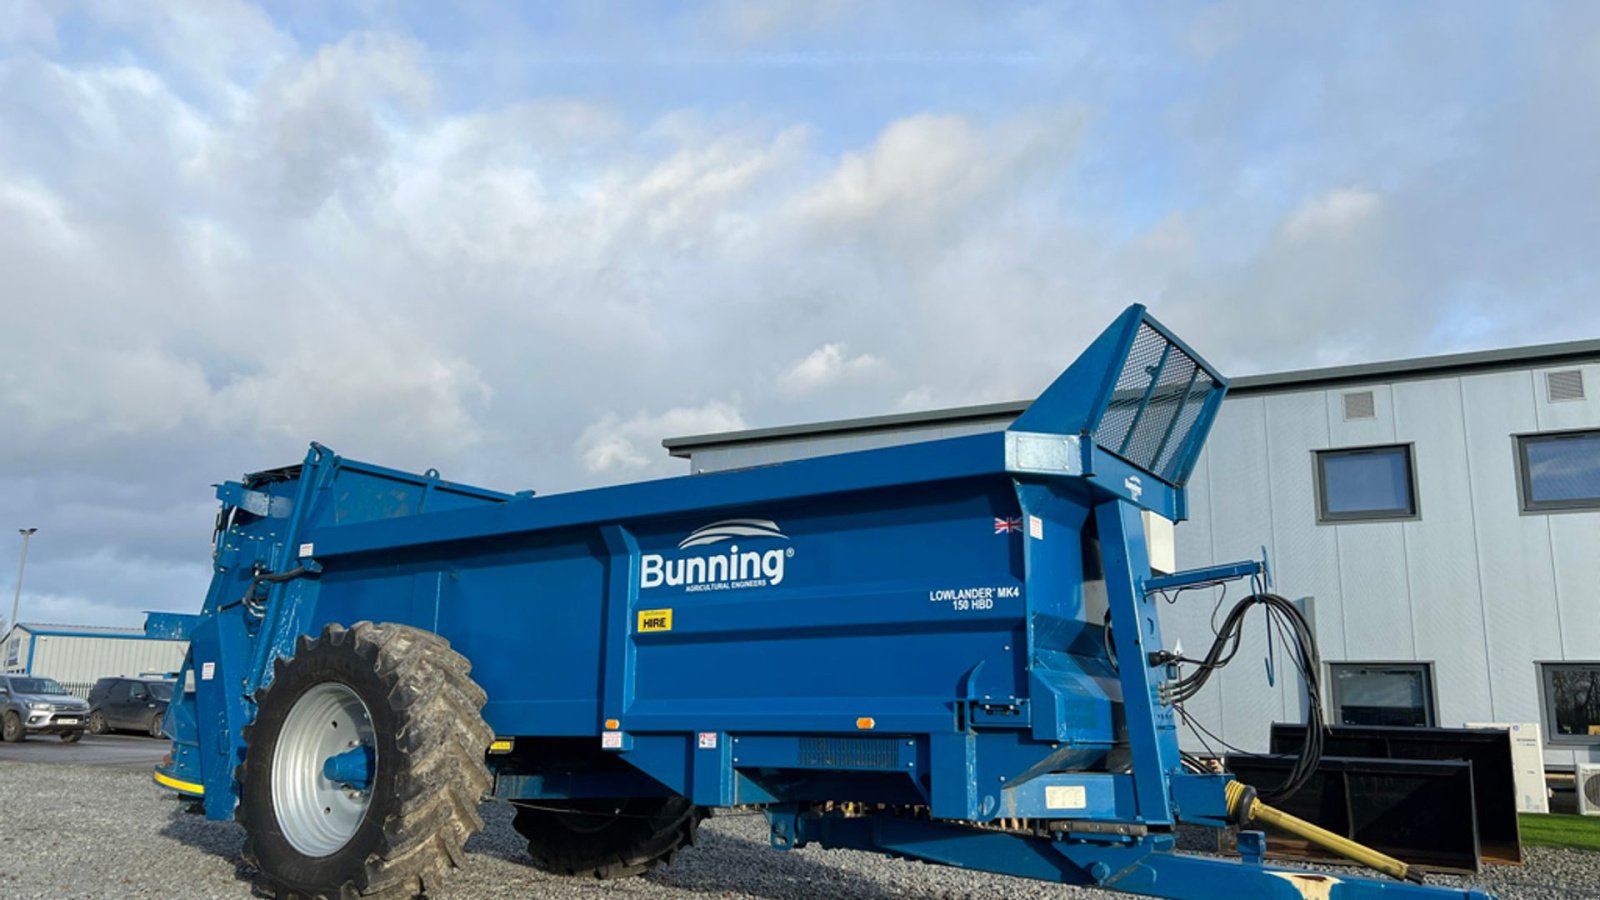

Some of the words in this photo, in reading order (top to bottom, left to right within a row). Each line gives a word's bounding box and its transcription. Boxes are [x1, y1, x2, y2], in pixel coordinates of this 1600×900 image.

[685, 582, 730, 592] AGRICULTURAL
[731, 579, 767, 589] ENGINEERS
[929, 588, 993, 601] LOWLANDER
[997, 586, 1020, 598] MK4
[953, 600, 969, 610] 150
[971, 599, 994, 610] HBD
[643, 617, 666, 628] HIRE
